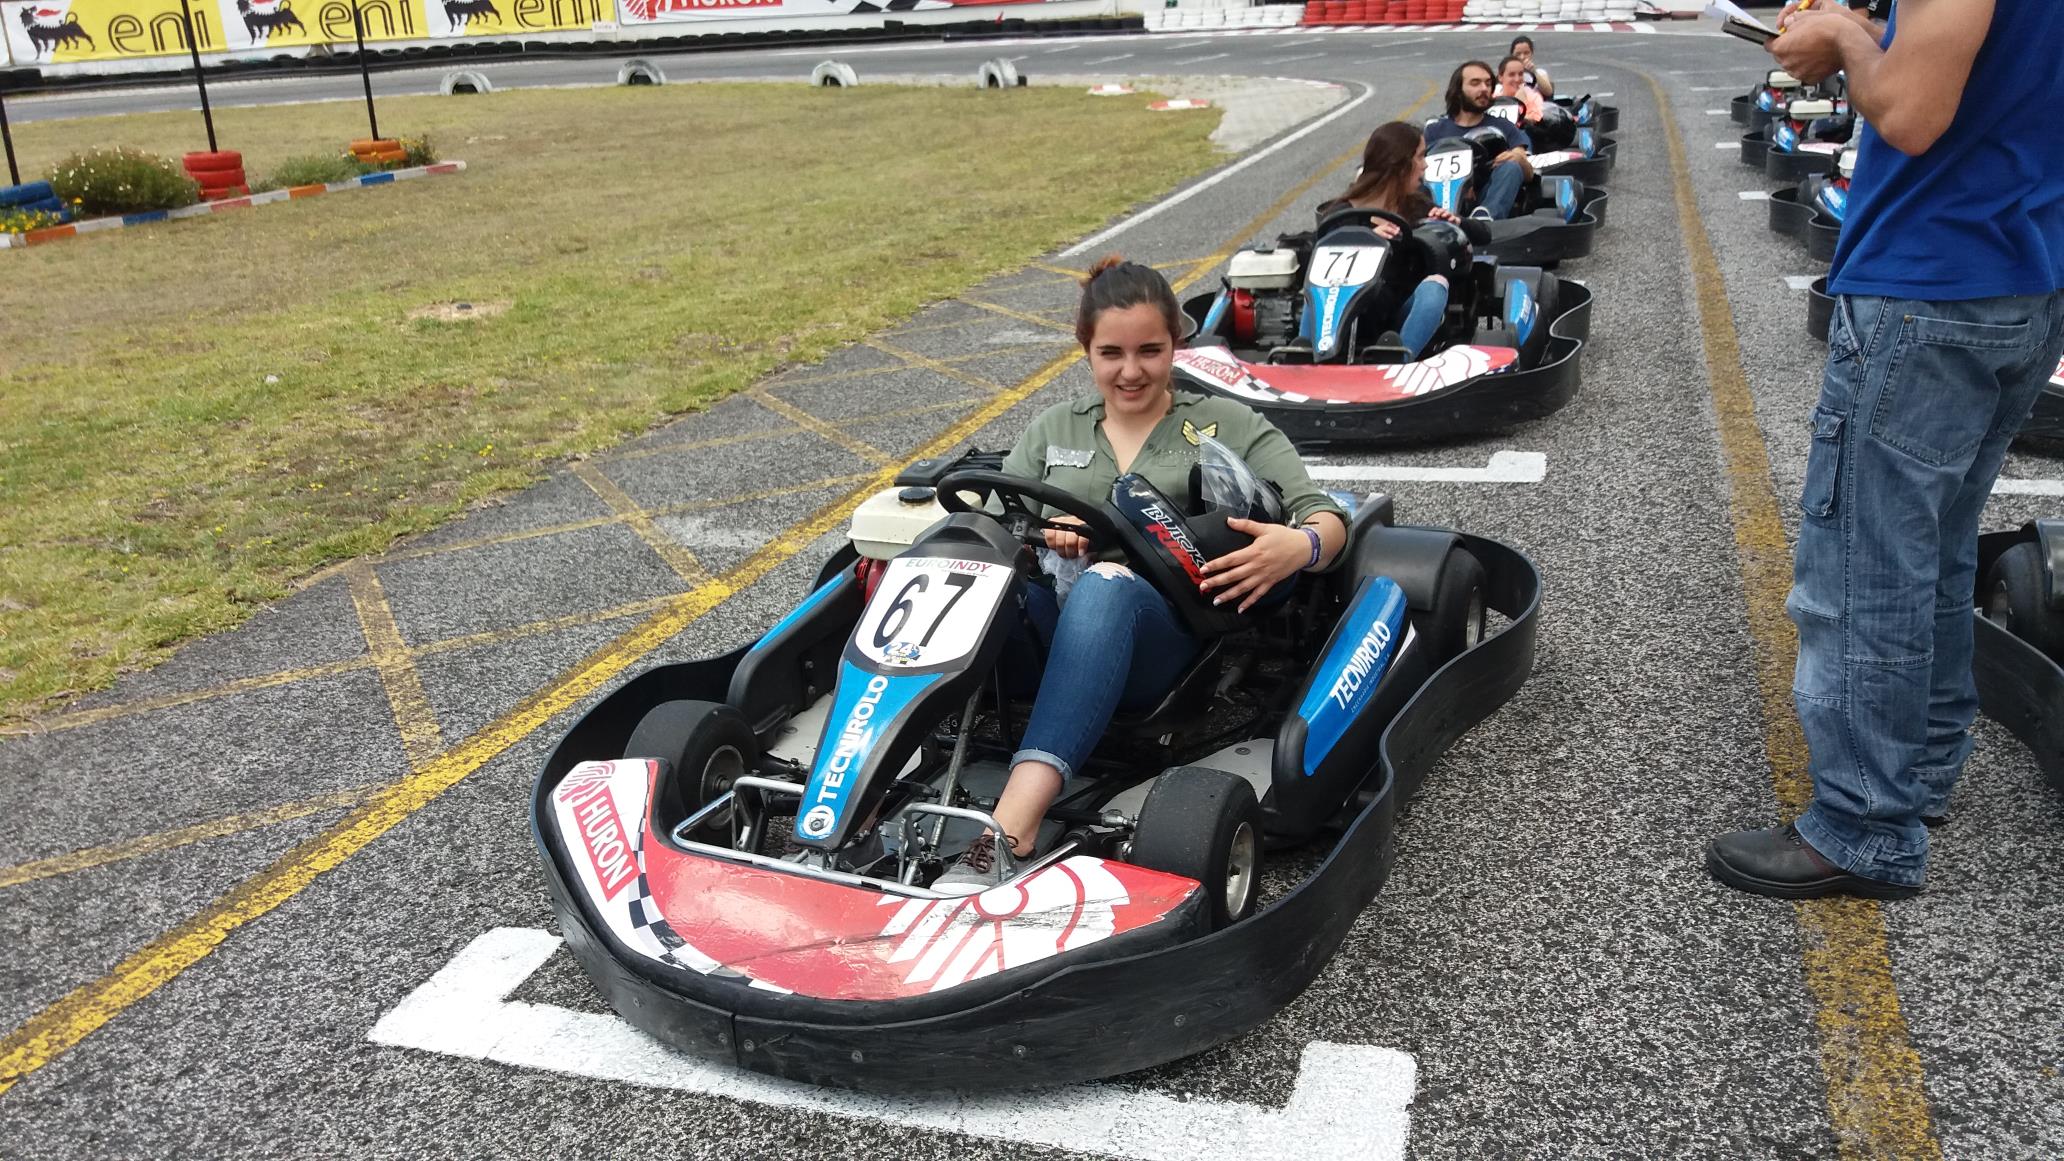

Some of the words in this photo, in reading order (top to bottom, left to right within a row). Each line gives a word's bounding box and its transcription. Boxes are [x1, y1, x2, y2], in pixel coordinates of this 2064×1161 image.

[108, 9, 212, 54] eni
[319, 0, 415, 40] eni
[1434, 155, 1461, 177] 75
[1324, 250, 1360, 280] 71
[1190, 357, 1241, 385] HURON
[1140, 503, 1207, 569] BLACK
[905, 558, 993, 573] EUROINDY
[873, 572, 978, 649] 67
[1329, 620, 1391, 711] TECNIROLO
[817, 675, 889, 803] TECNIROLO
[580, 795, 633, 890] HURON
